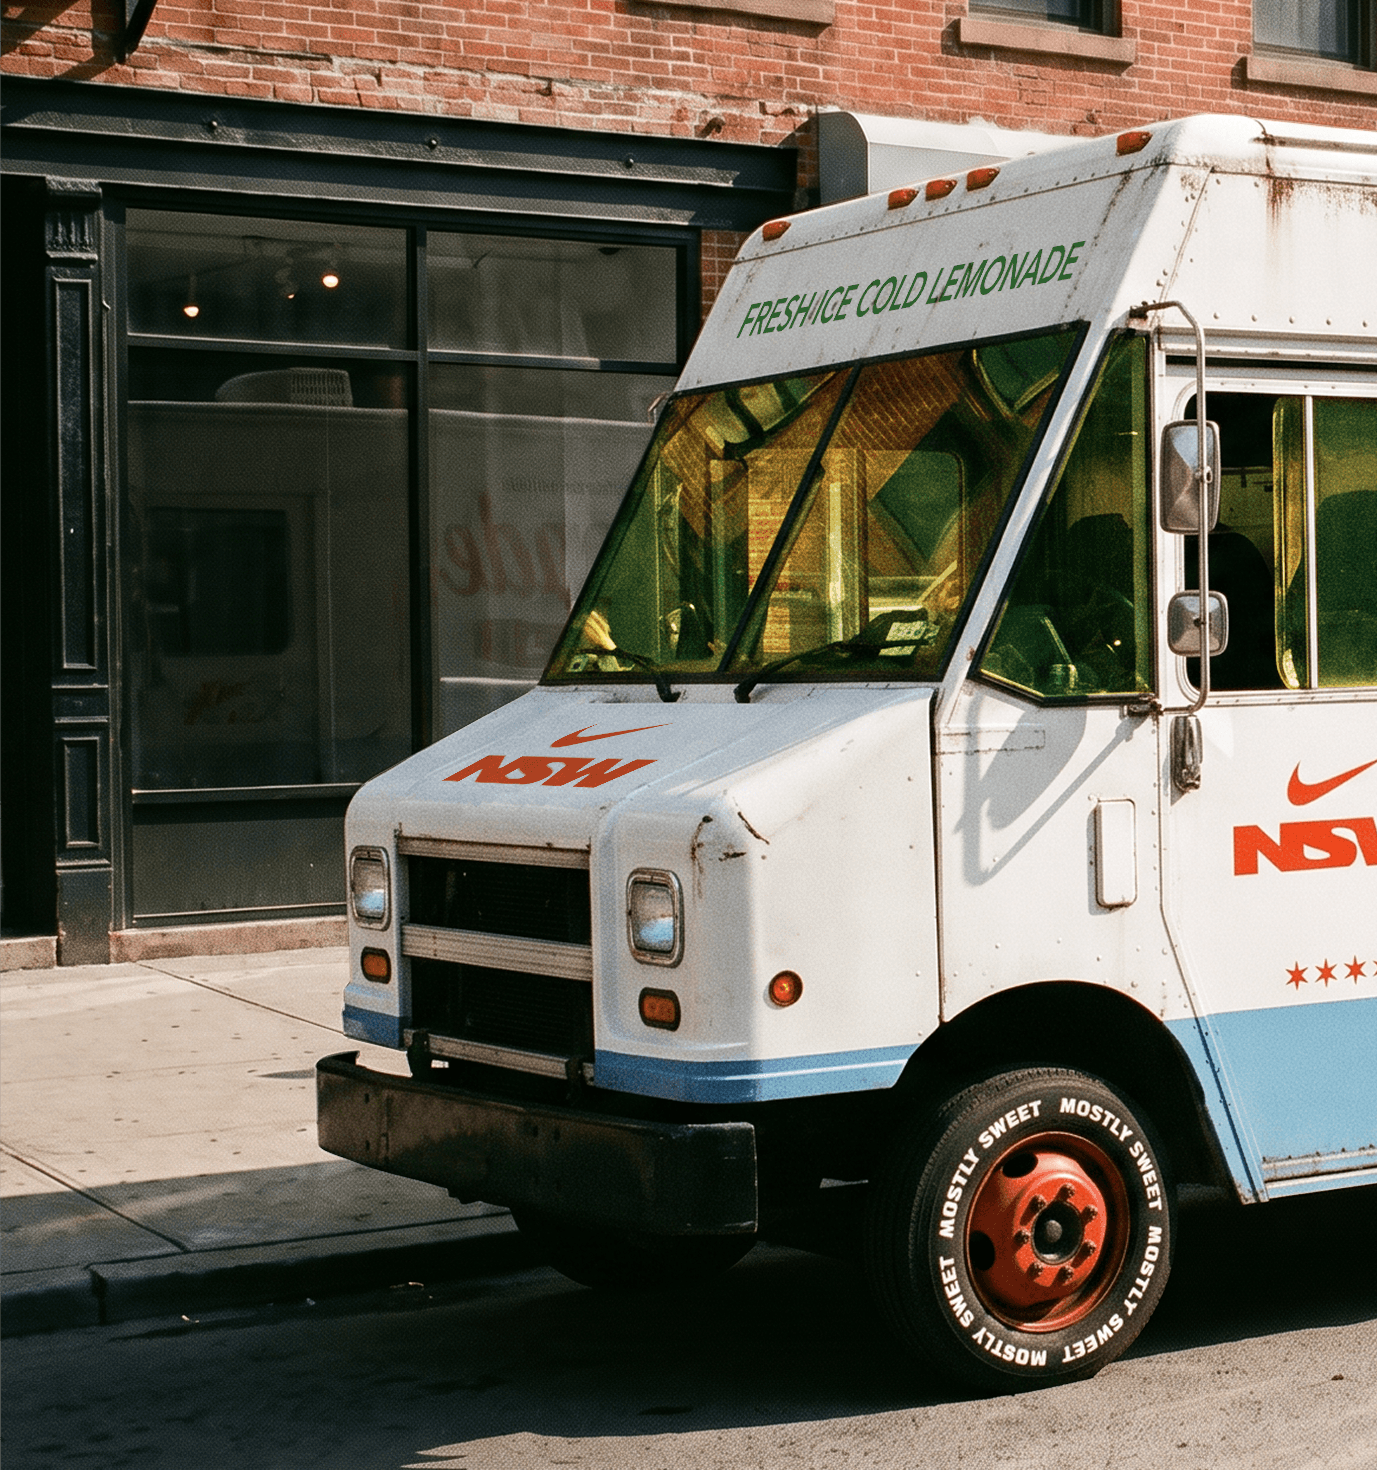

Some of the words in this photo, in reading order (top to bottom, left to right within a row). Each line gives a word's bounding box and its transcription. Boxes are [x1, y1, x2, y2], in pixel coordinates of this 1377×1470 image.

[736, 291, 818, 339] FRESH
[811, 283, 860, 325] ICE
[856, 271, 928, 317] COLD
[926, 240, 1086, 304] LEMONADE
[442, 755, 659, 788] NSW
[939, 1148, 982, 1239] MOSTLY
[978, 1100, 1042, 1149] SWEET
[1060, 1097, 1133, 1142] MOSTLY
[1129, 1141, 1163, 1210] SWEET
[939, 1256, 974, 1328] SWEET
[1123, 1225, 1163, 1316] MOSTLY
[972, 1326, 1047, 1366] MOSTLY
[1061, 1313, 1124, 1364] SWEET
